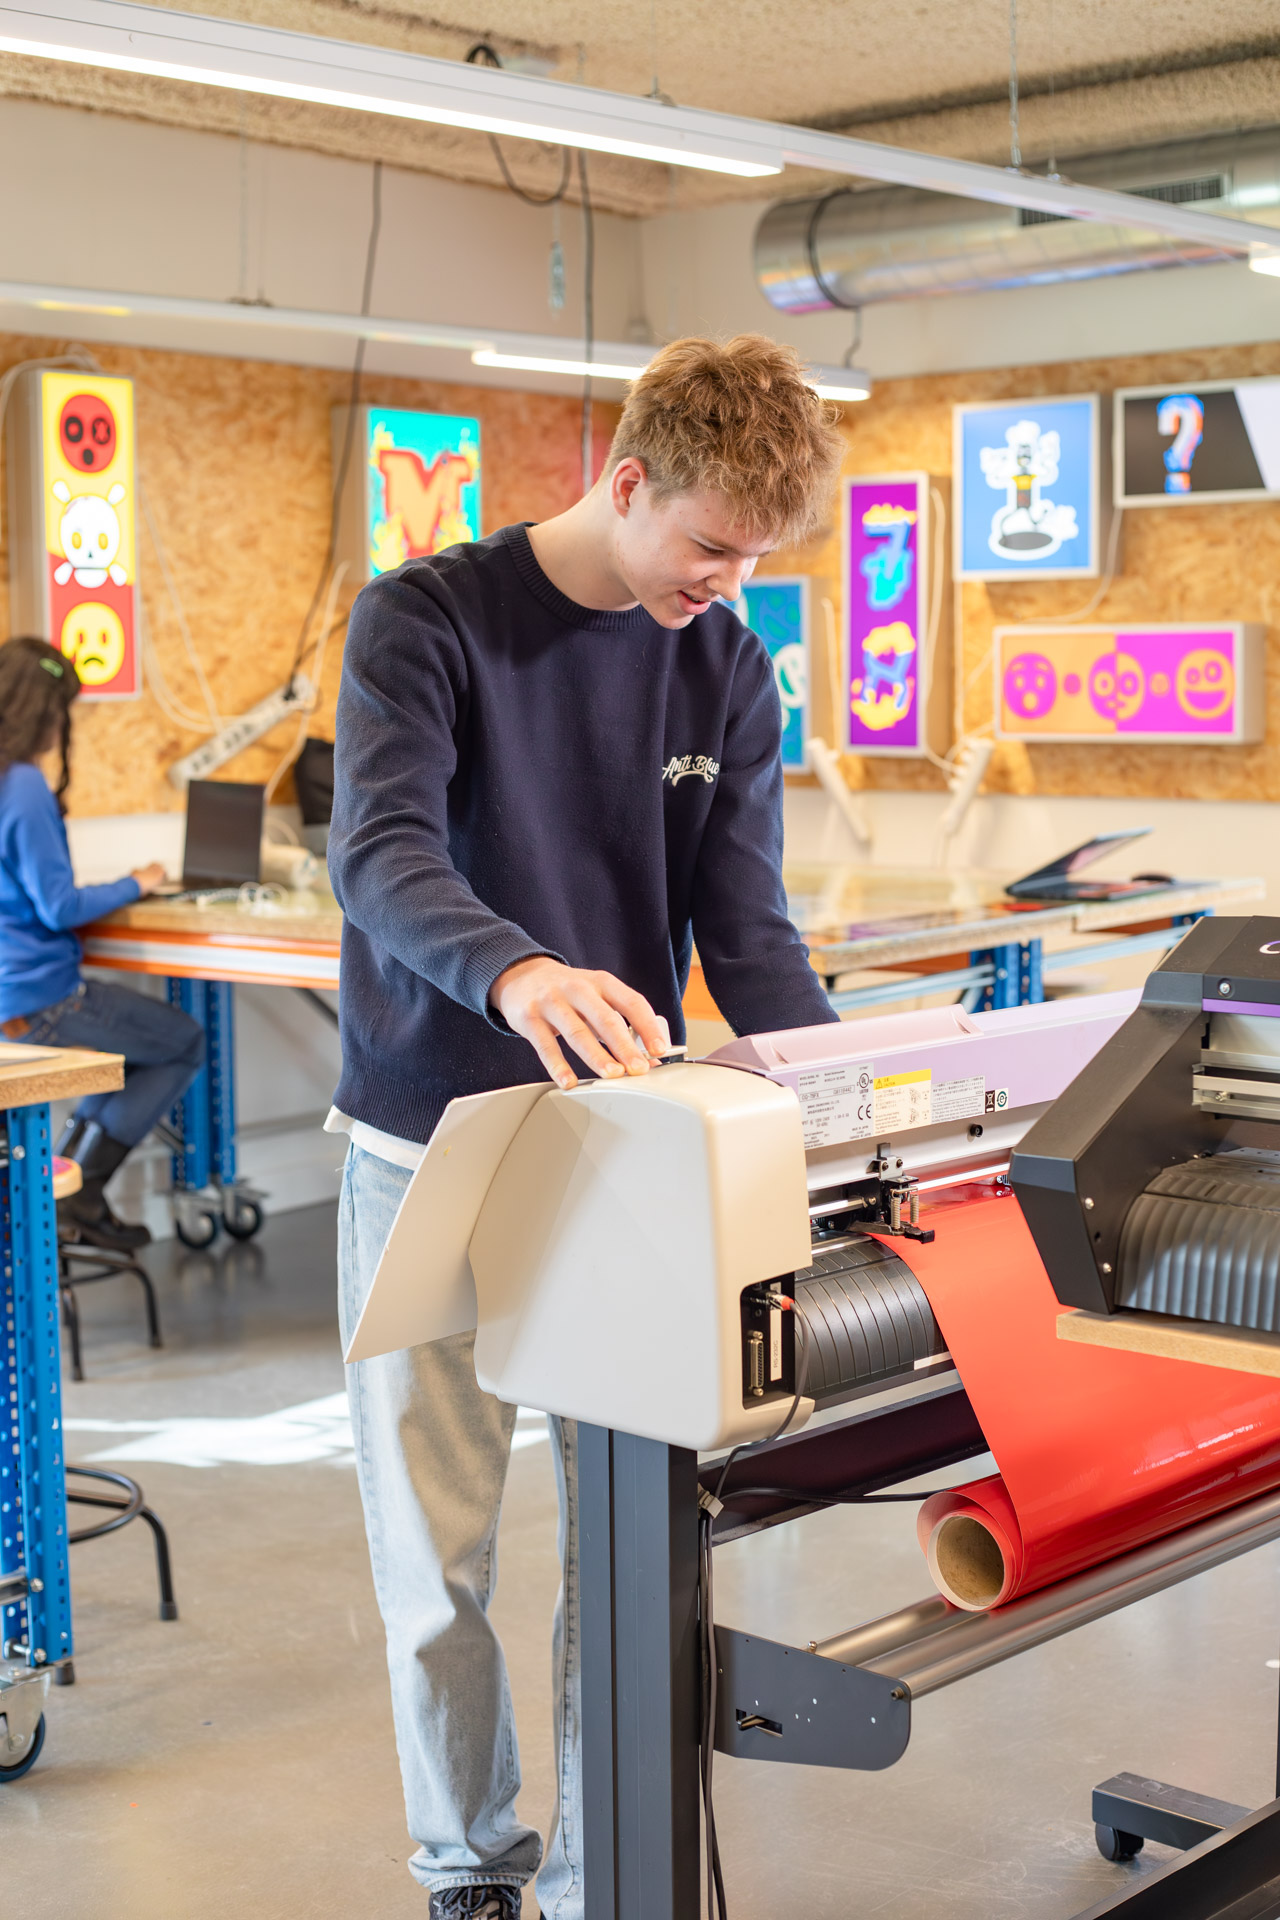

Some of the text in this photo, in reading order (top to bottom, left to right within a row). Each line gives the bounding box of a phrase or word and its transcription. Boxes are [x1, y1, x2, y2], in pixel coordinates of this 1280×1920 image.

[662, 754, 720, 783] Anti Blue
[857, 1103, 872, 1121] CE
